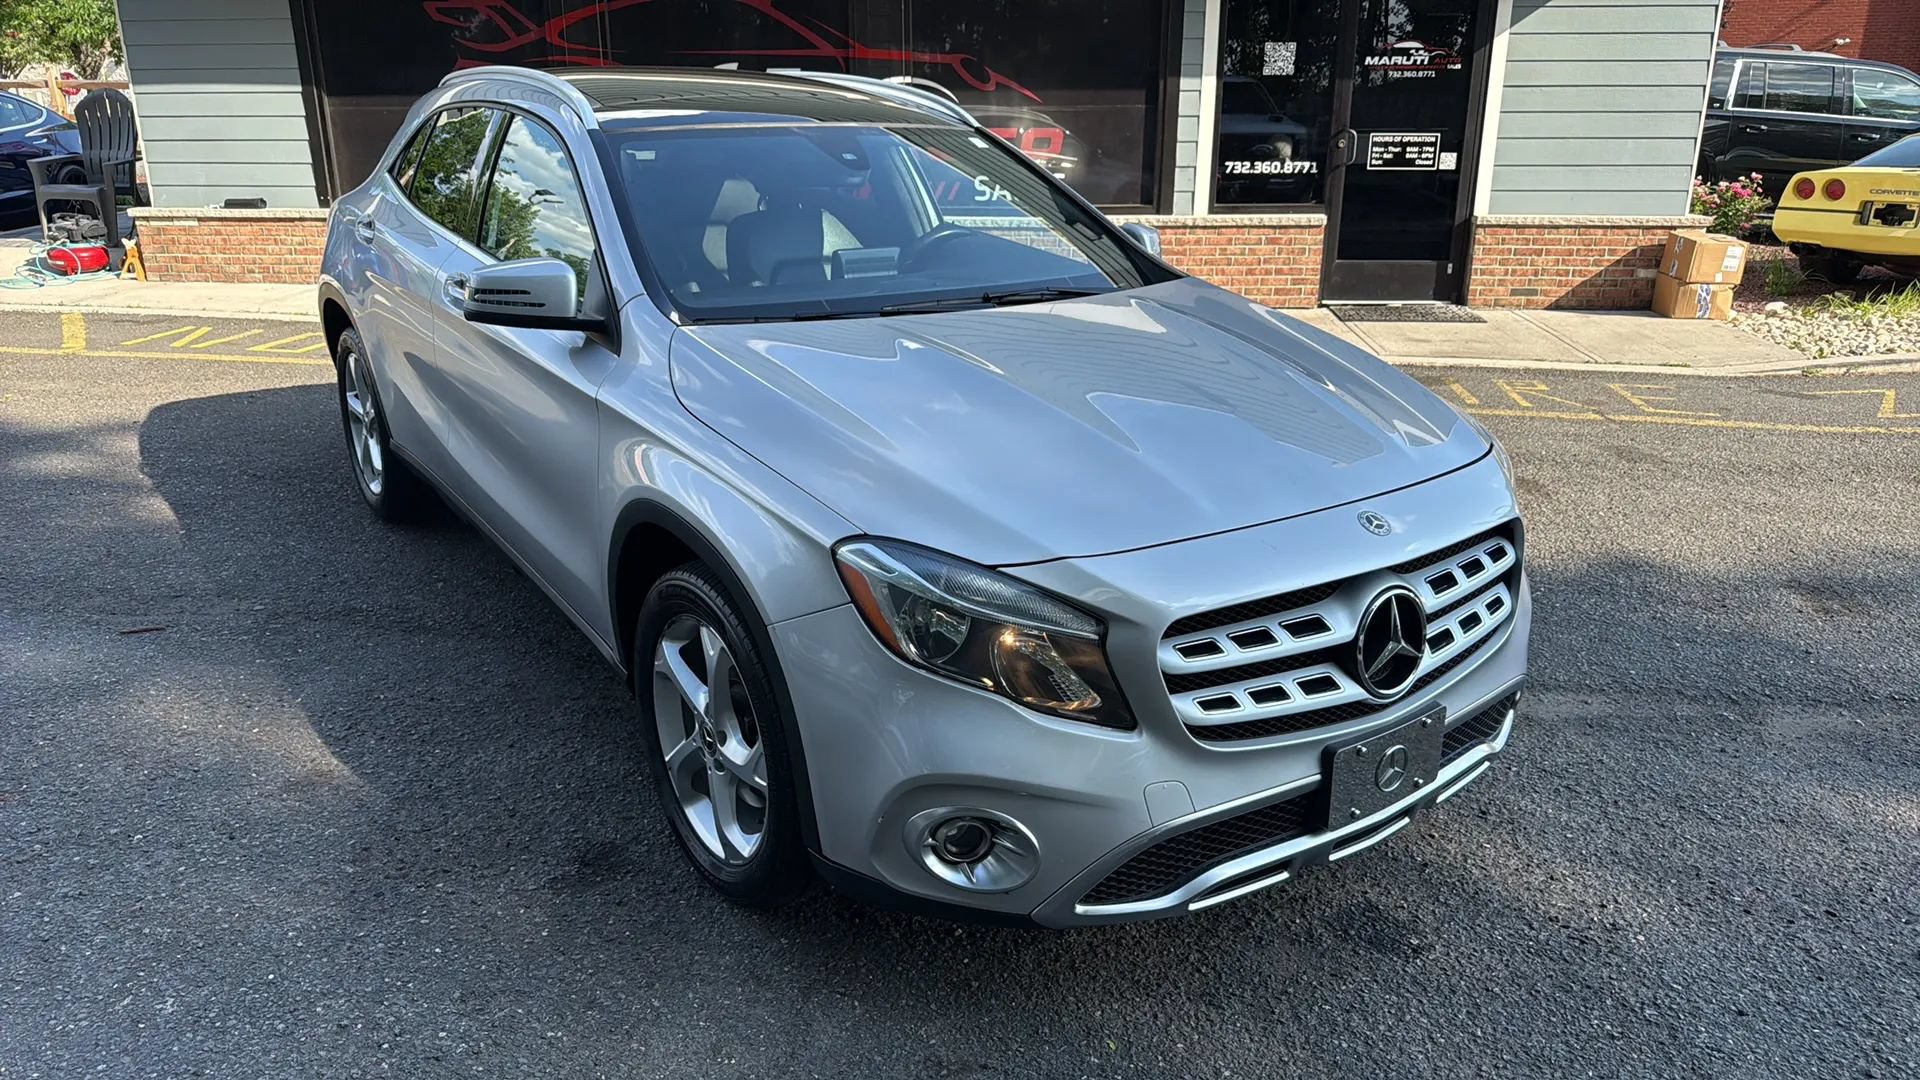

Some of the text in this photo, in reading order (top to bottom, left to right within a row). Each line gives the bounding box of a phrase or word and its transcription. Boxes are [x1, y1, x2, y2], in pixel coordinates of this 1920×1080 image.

[1364, 56, 1430, 65] MARUTI
[1388, 70, 1435, 78] 732.360.8771
[1224, 161, 1318, 174] 732.360.8771
